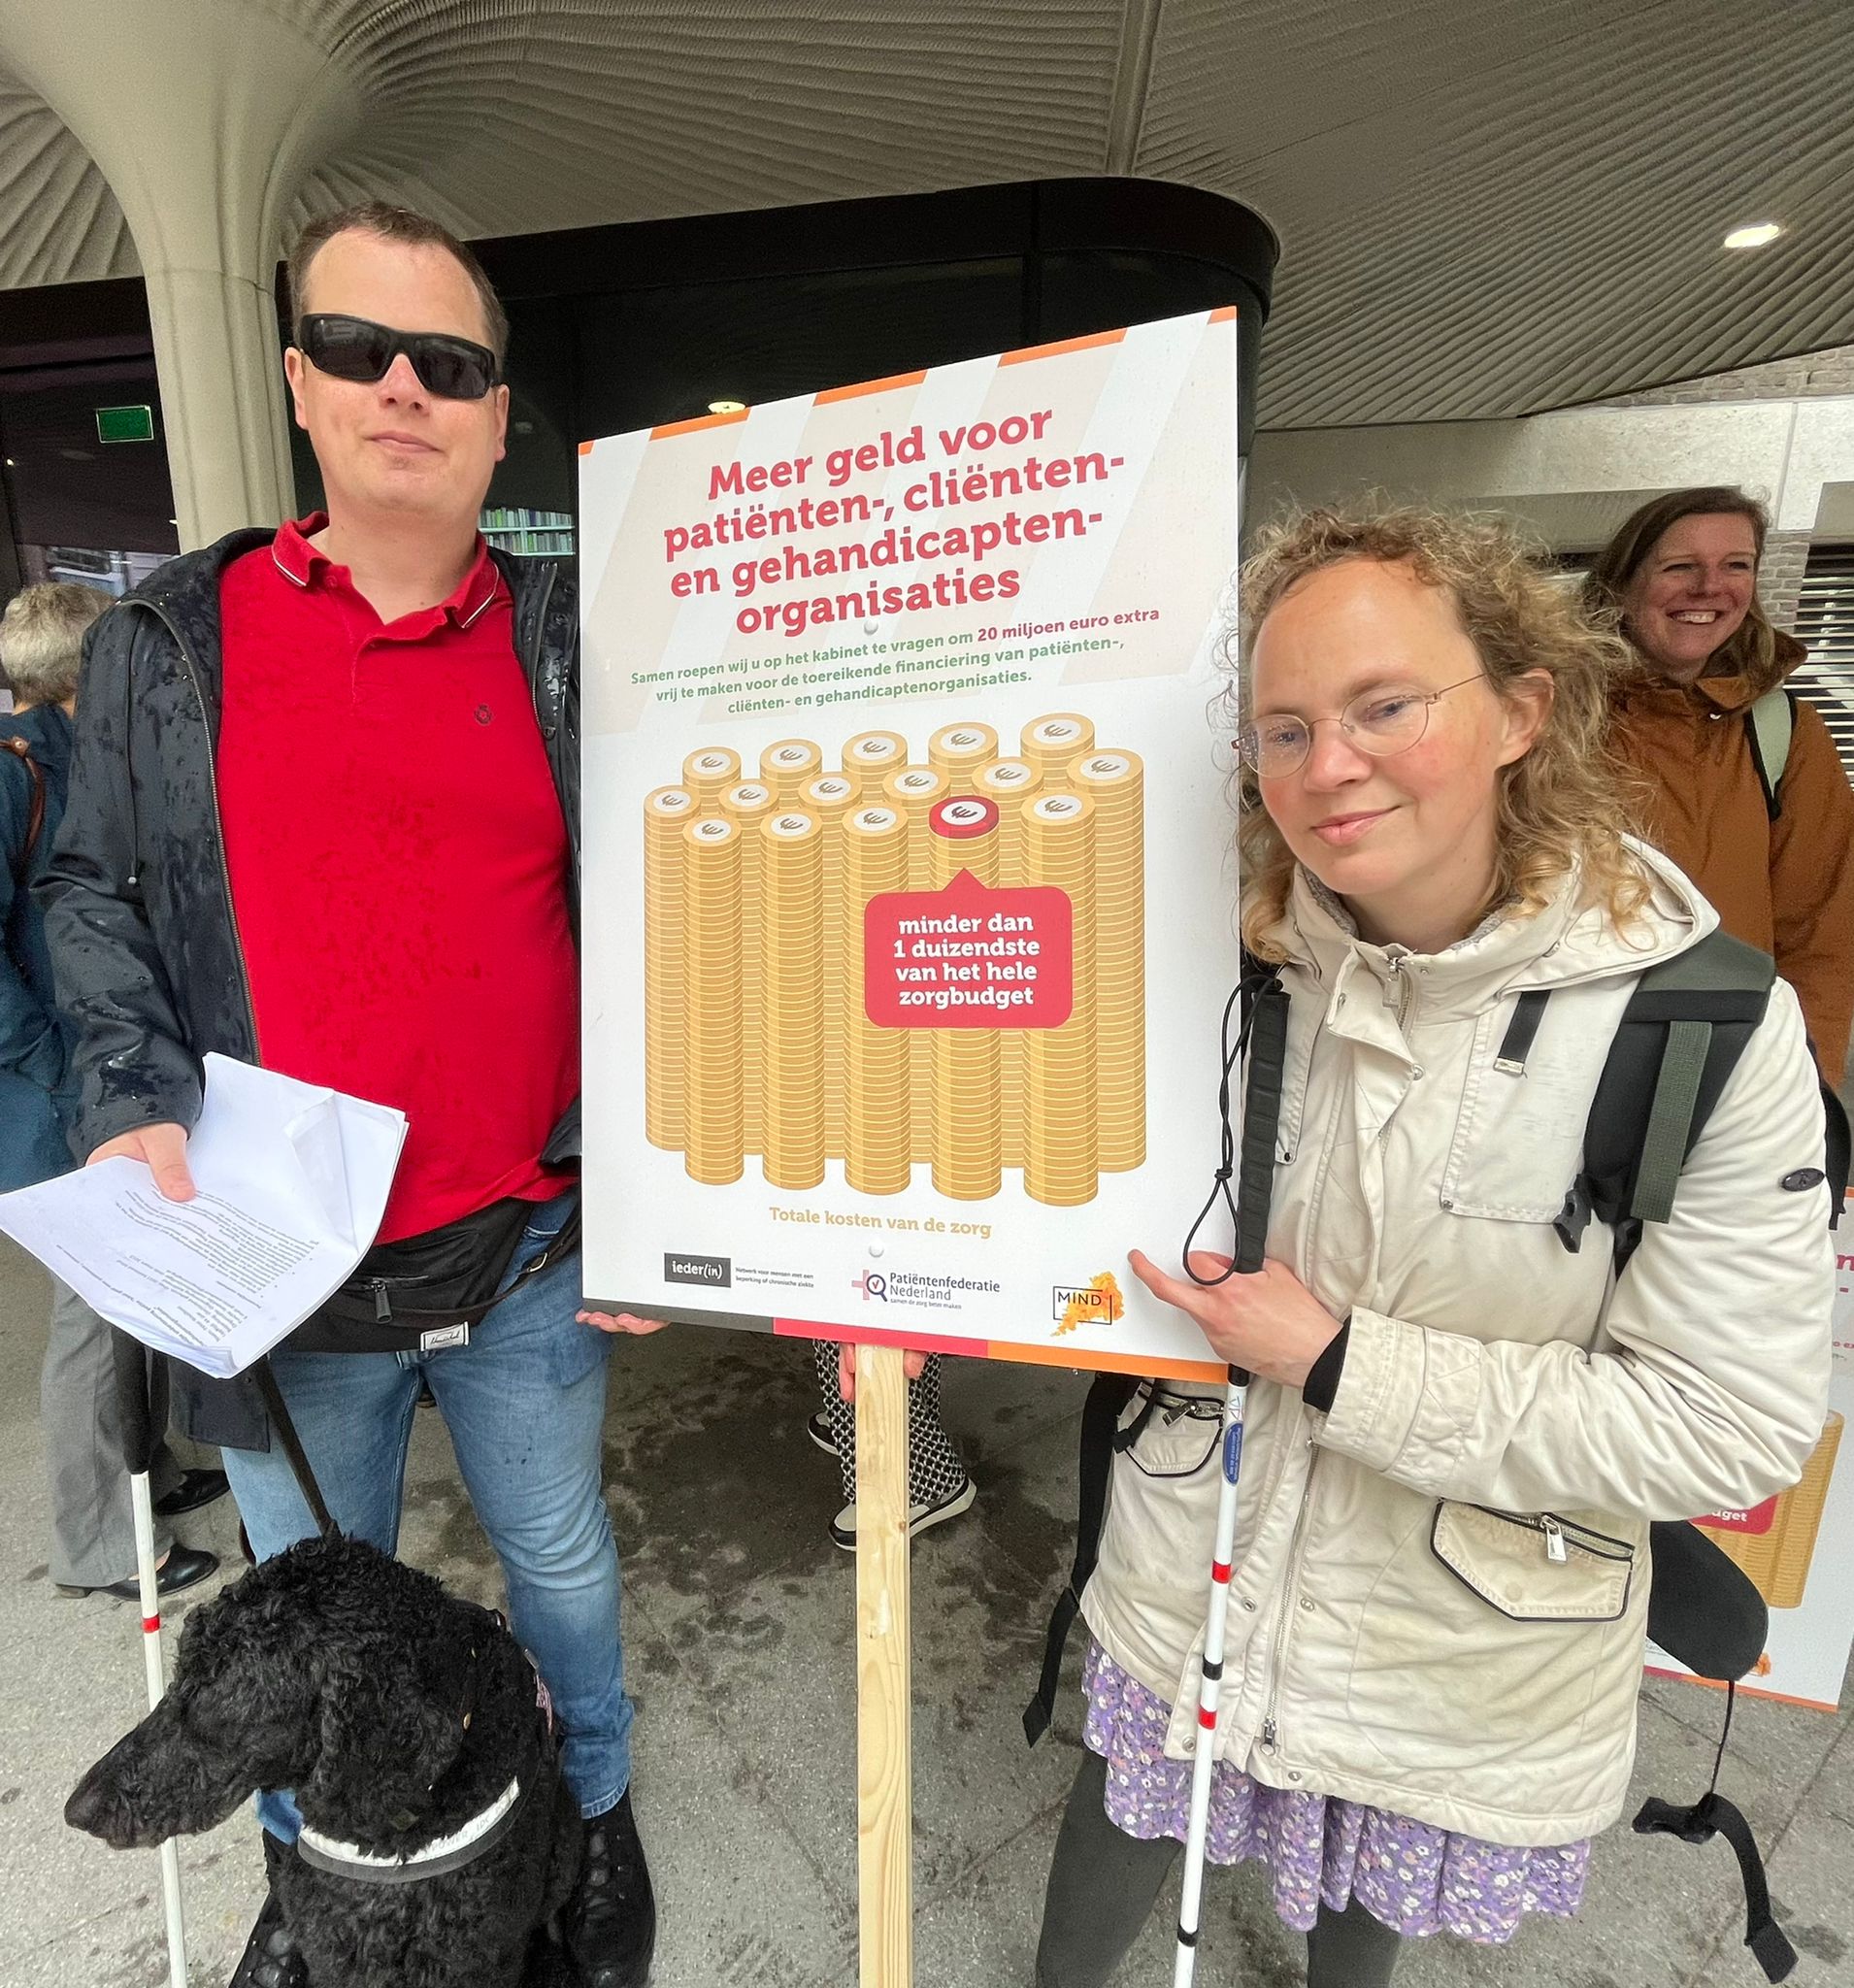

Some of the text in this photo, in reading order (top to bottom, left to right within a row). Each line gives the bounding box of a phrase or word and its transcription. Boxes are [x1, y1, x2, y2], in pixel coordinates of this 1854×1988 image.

[708, 410, 1052, 500] Meer geld voor
[664, 452, 1124, 563] patiënten-, cliënten-
[671, 509, 1103, 597] en gehandicapten-
[736, 567, 1020, 637] organisaties
[631, 610, 1160, 684] Samen roepen wij u op het kabinet te vragen om 20 miljoen euro extra
[656, 638, 1125, 703] vrij te maken voor de toereikende financiering van patiënten-,
[728, 670, 1032, 713] cliënten- en gehandicaptenorganisaties.
[898, 913, 1034, 935] minder dan
[893, 937, 1041, 958] 1 duizendste
[895, 961, 1037, 981] van het hele
[899, 986, 1034, 1010] zorgbudget
[769, 1207, 992, 1240] Totale kosten van de zorg
[672, 1260, 722, 1280] ieder(in)
[889, 1272, 1001, 1293] Patiëntenfederatie
[890, 1285, 951, 1301] Nederland
[1057, 1291, 1102, 1306] MIND
